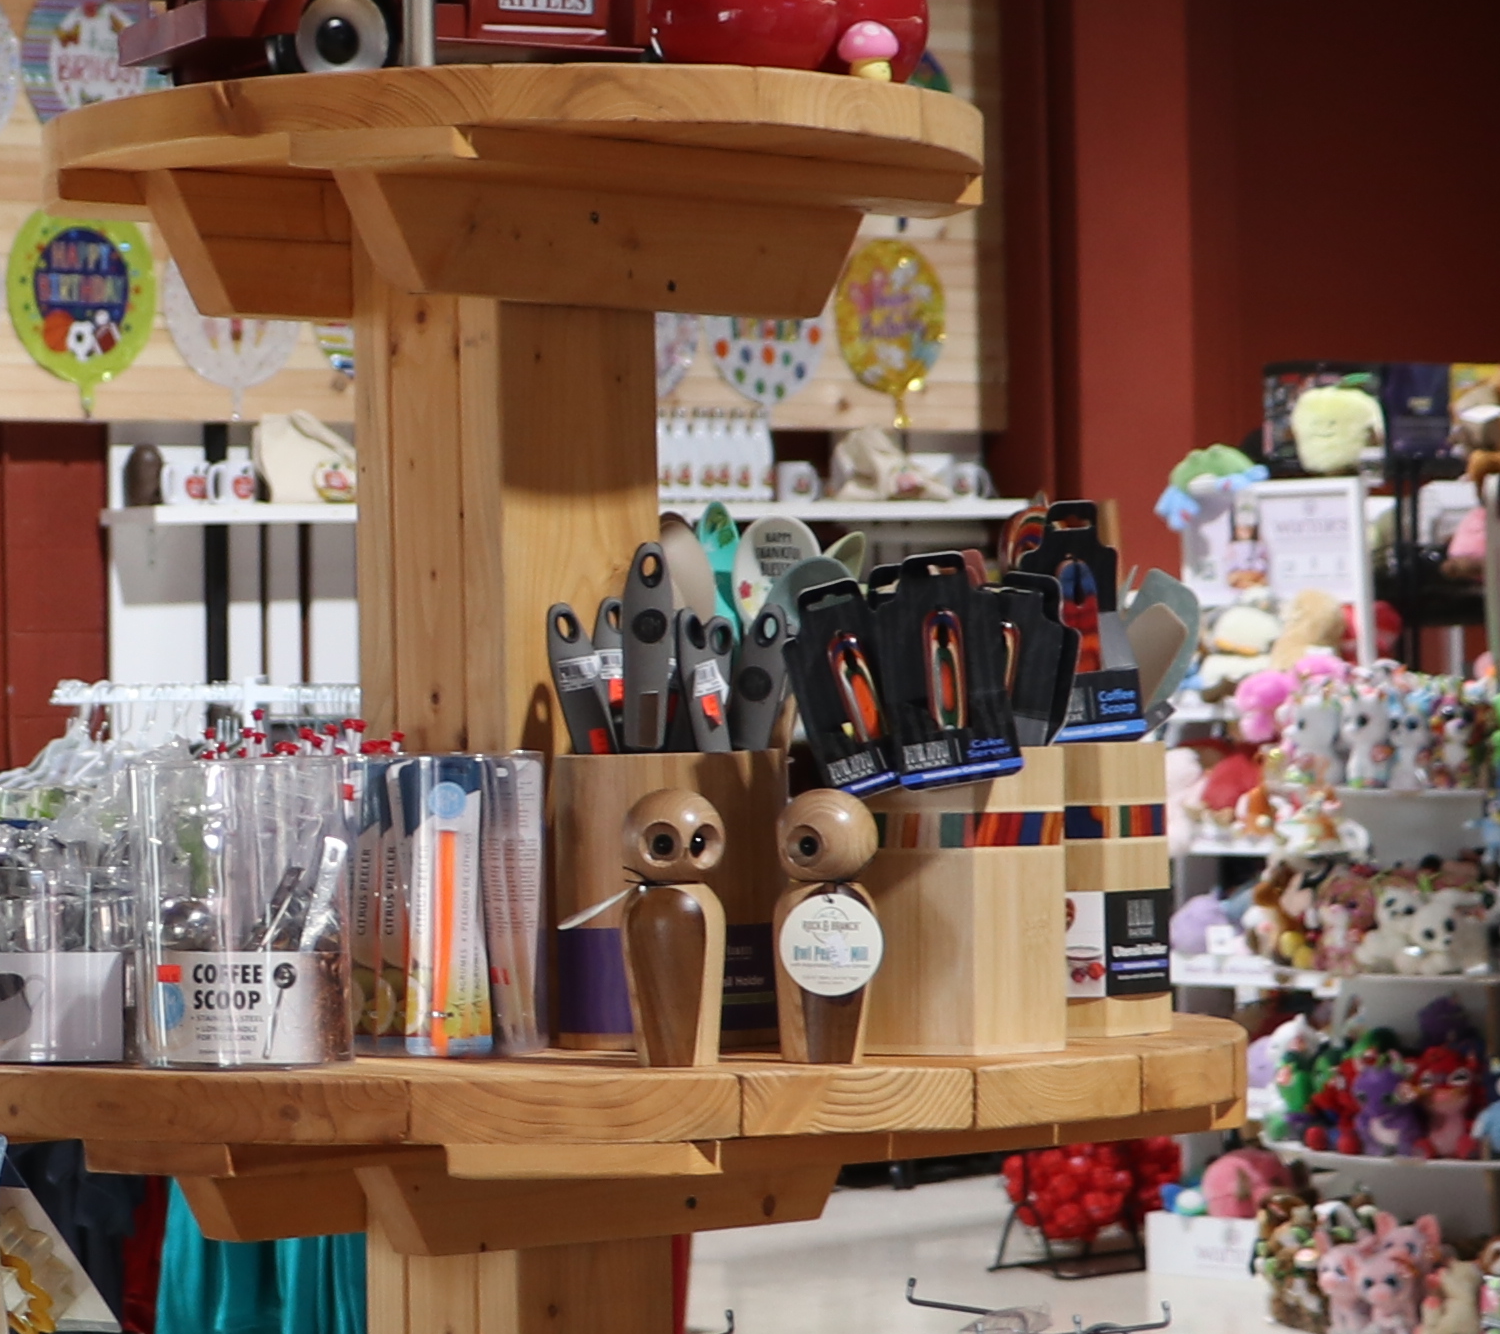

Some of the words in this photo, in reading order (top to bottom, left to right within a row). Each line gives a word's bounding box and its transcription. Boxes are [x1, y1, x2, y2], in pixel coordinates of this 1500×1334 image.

[51, 240, 111, 269] HAPPY
[36, 273, 125, 305] BIRTHDAY
[1098, 687, 1137, 703] Coffee
[1099, 702, 1138, 715] Scoop
[966, 745, 1013, 760] Server
[970, 737, 1005, 749] Cake
[358, 848, 371, 892] PEELER
[385, 845, 397, 891] PEELER
[461, 874, 472, 888] DE
[356, 893, 370, 937] CITRUS
[383, 893, 396, 936] CITRUS
[460, 889, 472, 932] PELADOR
[192, 963, 264, 985] COFFEE
[458, 948, 468, 993] AGRUMES
[193, 989, 261, 1010] SCOOP
[240, 1015, 265, 1023] STEEL
